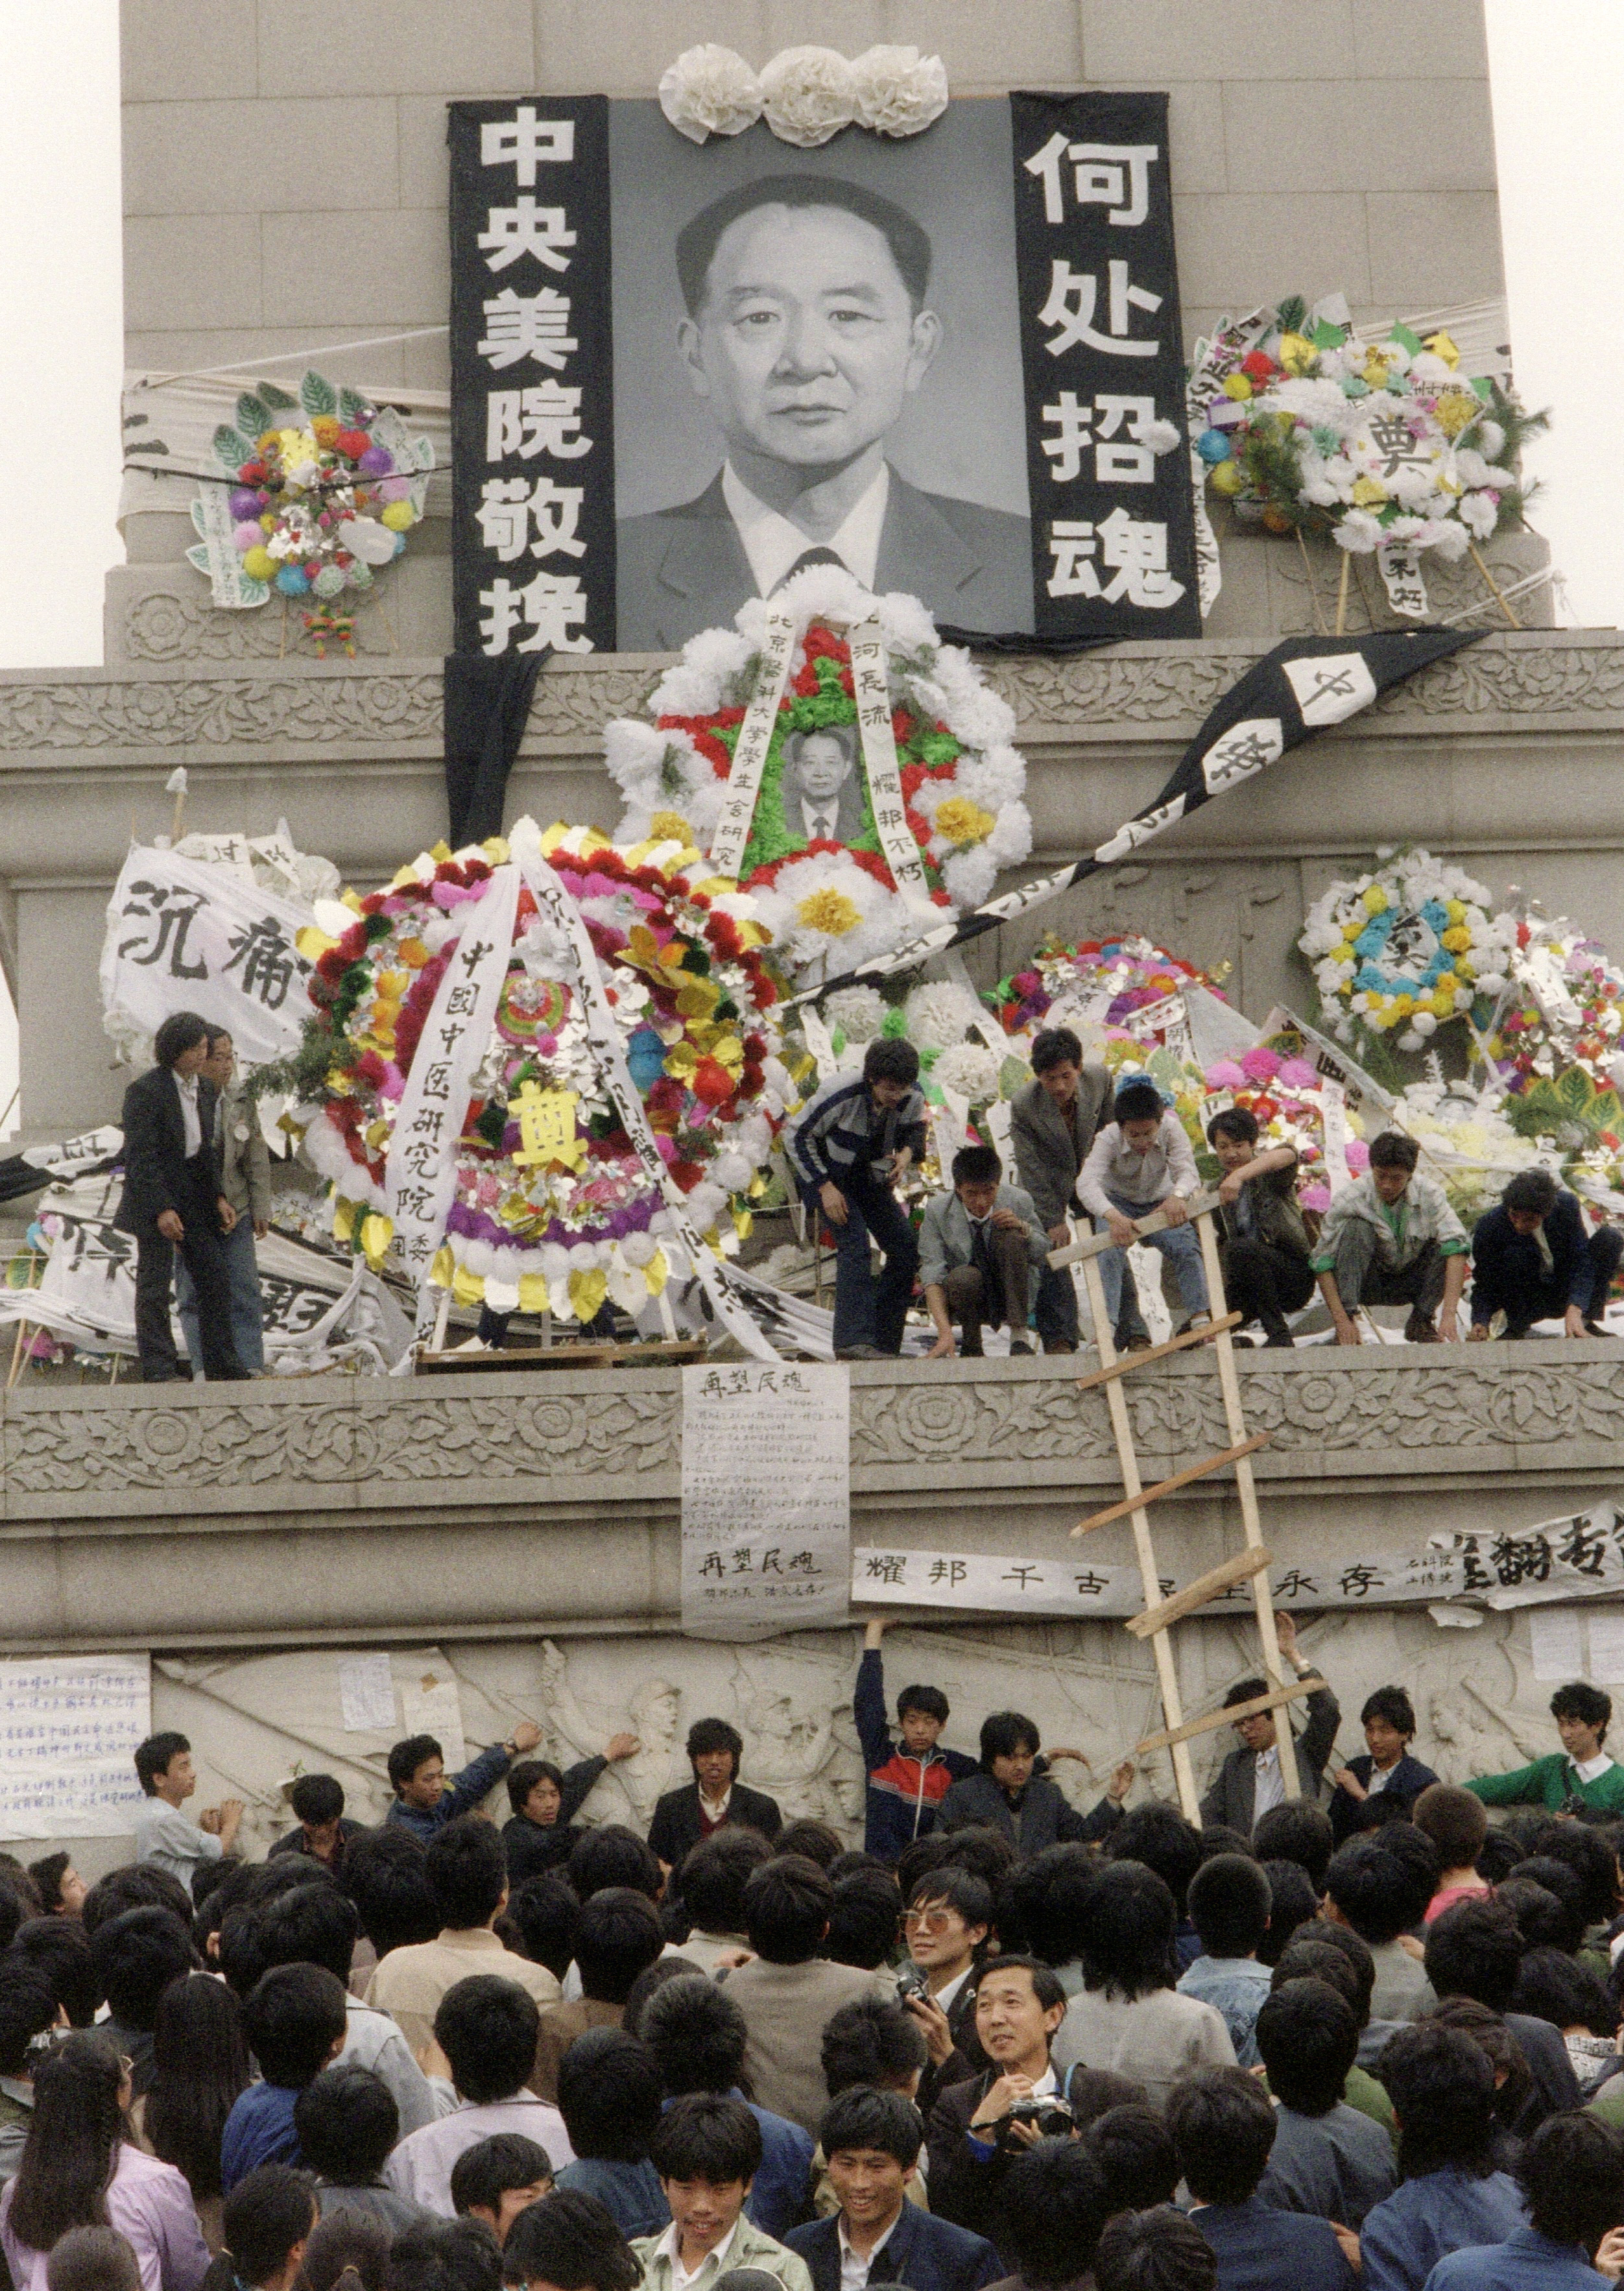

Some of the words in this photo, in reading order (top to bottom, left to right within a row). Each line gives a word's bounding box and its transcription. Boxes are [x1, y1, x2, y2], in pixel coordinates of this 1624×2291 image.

[475, 106, 594, 656] 中央美院敬挽
[1024, 132, 1186, 610] 何处招魂
[1384, 544, 1422, 610] 不朽
[118, 880, 312, 1011] 沉痛
